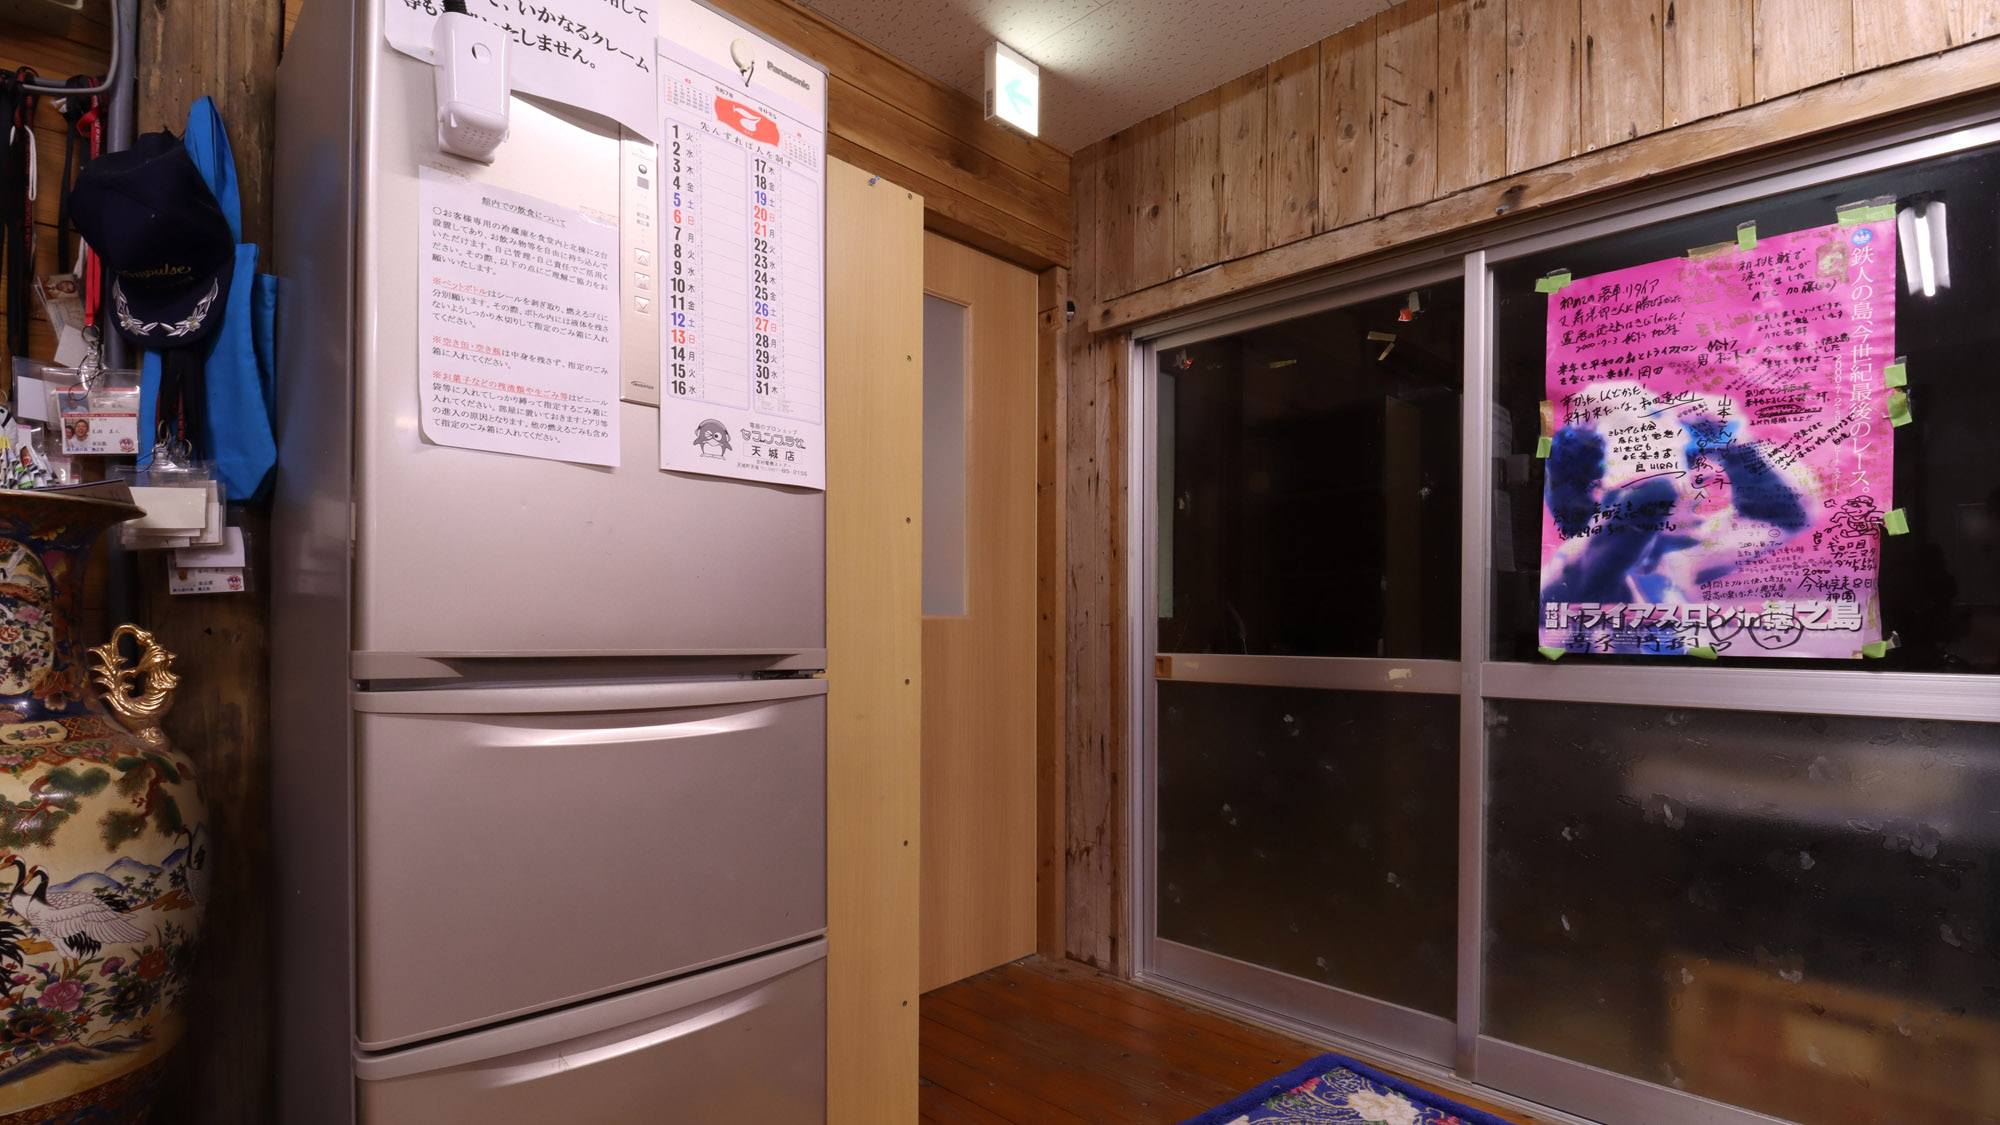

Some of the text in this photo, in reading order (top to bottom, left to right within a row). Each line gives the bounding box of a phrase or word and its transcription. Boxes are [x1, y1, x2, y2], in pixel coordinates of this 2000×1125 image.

[767, 60, 810, 91] Panasonic
[672, 124, 694, 143] 1 火
[673, 142, 694, 159] 2 水
[673, 158, 694, 175] 3 木
[754, 158, 775, 176] 17 木
[673, 176, 694, 193] 4 金
[754, 175, 775, 192] 18 金
[674, 192, 695, 210] 5 土
[754, 191, 775, 208] 19 土
[482, 196, 567, 228] 館内での飲食について
[673, 209, 695, 226] 6 日
[754, 205, 775, 222] 20 日
[674, 226, 695, 243] 7 月
[754, 221, 775, 239] 21 月
[674, 244, 695, 260] 8 火
[754, 238, 776, 255] 22 火
[432, 253, 497, 276] 願いいたします。
[674, 260, 695, 276] 9 水
[754, 254, 776, 270] 23 水
[670, 277, 696, 293] 10 木
[754, 270, 776, 285] 24 木
[755, 286, 777, 301] 25 金
[670, 295, 696, 311] 11 金
[755, 301, 777, 317] 26 土
[432, 312, 476, 329] てください。
[671, 312, 696, 328] 12 土
[755, 317, 777, 332] 27 日
[671, 329, 696, 345] 13 日
[755, 333, 777, 348] 28 月
[432, 346, 512, 370] 箱に入れてください。
[671, 346, 695, 362] 14 月
[756, 349, 778, 364] 29 火
[671, 363, 696, 379] 15 火
[756, 365, 778, 380] 30 水
[1850, 248, 1875, 494] 鉄人の島、今世紀最後のレース。
[672, 380, 697, 396] 16 水
[756, 381, 778, 396] 31 木
[751, 445, 795, 462] 天城店
[1545, 602, 1863, 632] 第13回 トライアスロンin徳之島
